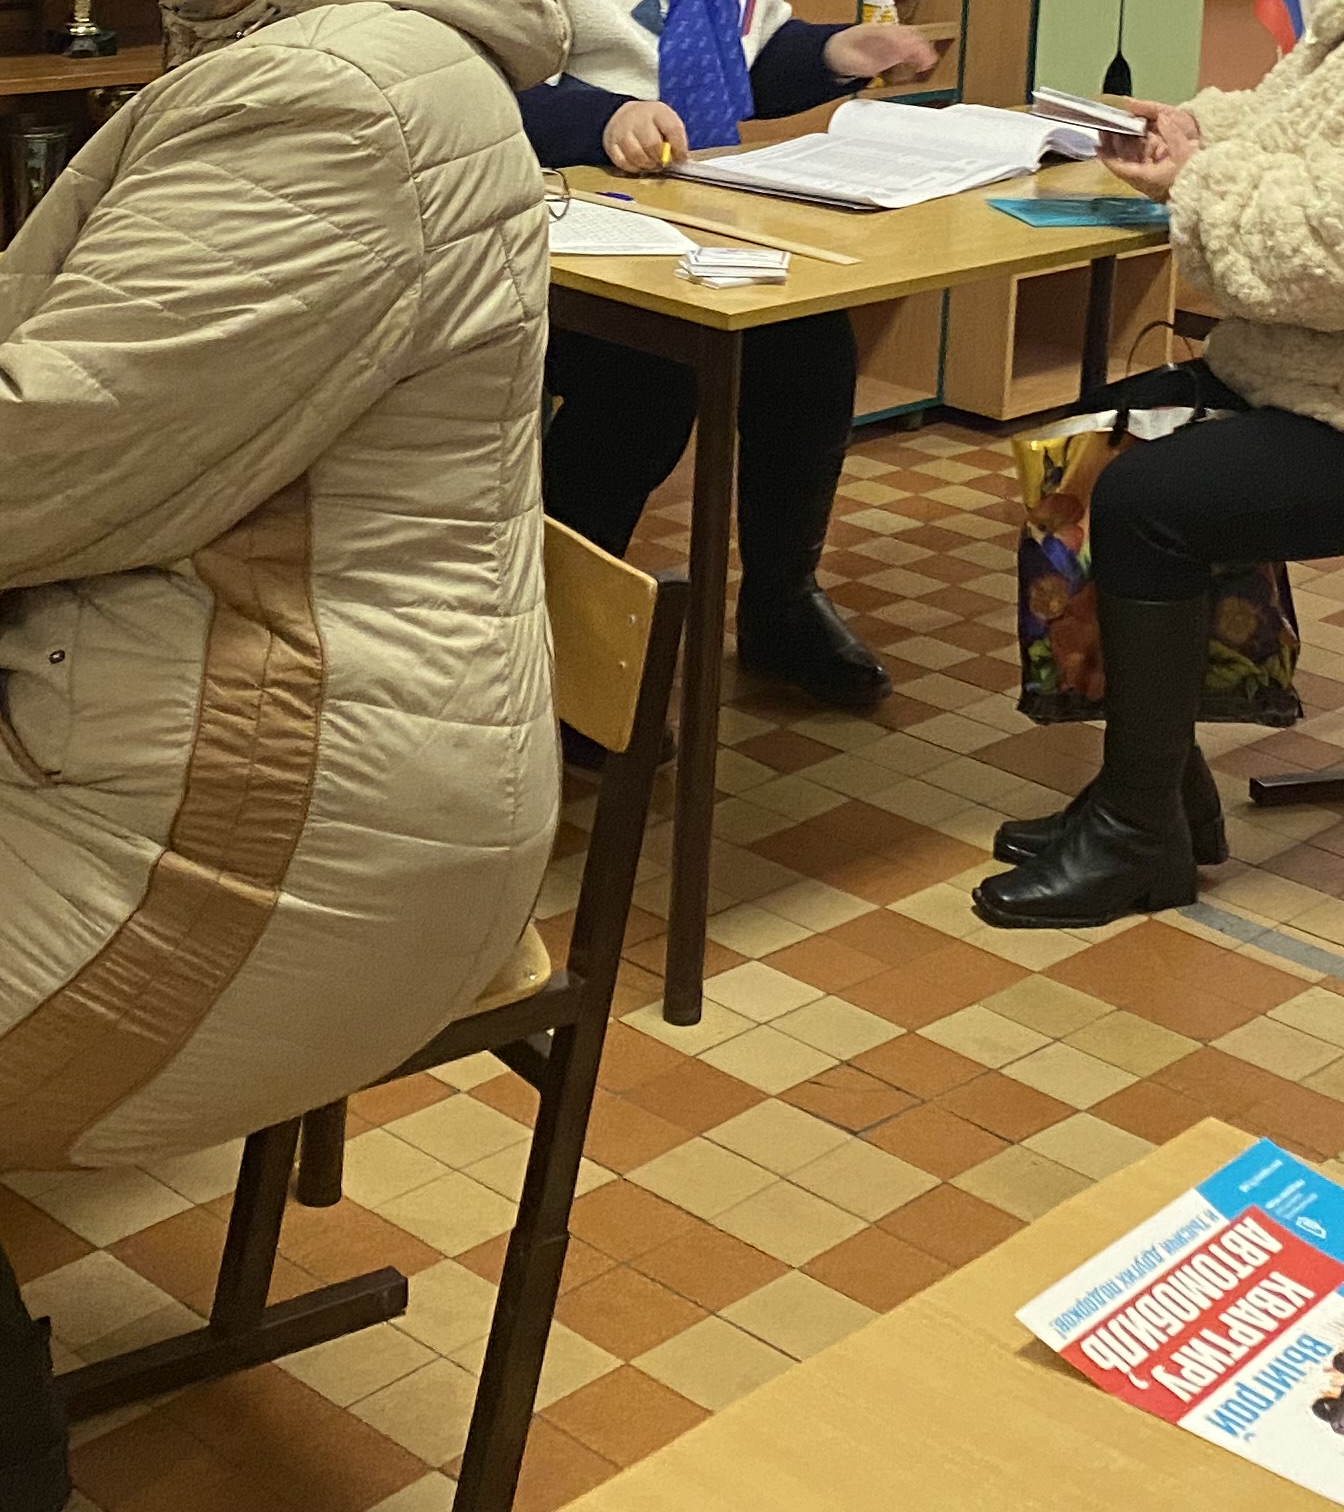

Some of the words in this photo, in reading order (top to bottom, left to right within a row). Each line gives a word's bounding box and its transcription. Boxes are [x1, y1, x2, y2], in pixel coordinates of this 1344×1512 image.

[1080, 1216, 1284, 1374] АВТОМОБИЛЬ
[1115, 1245, 1166, 1288] других
[1128, 1271, 1316, 1404] КВАРТИРУ,
